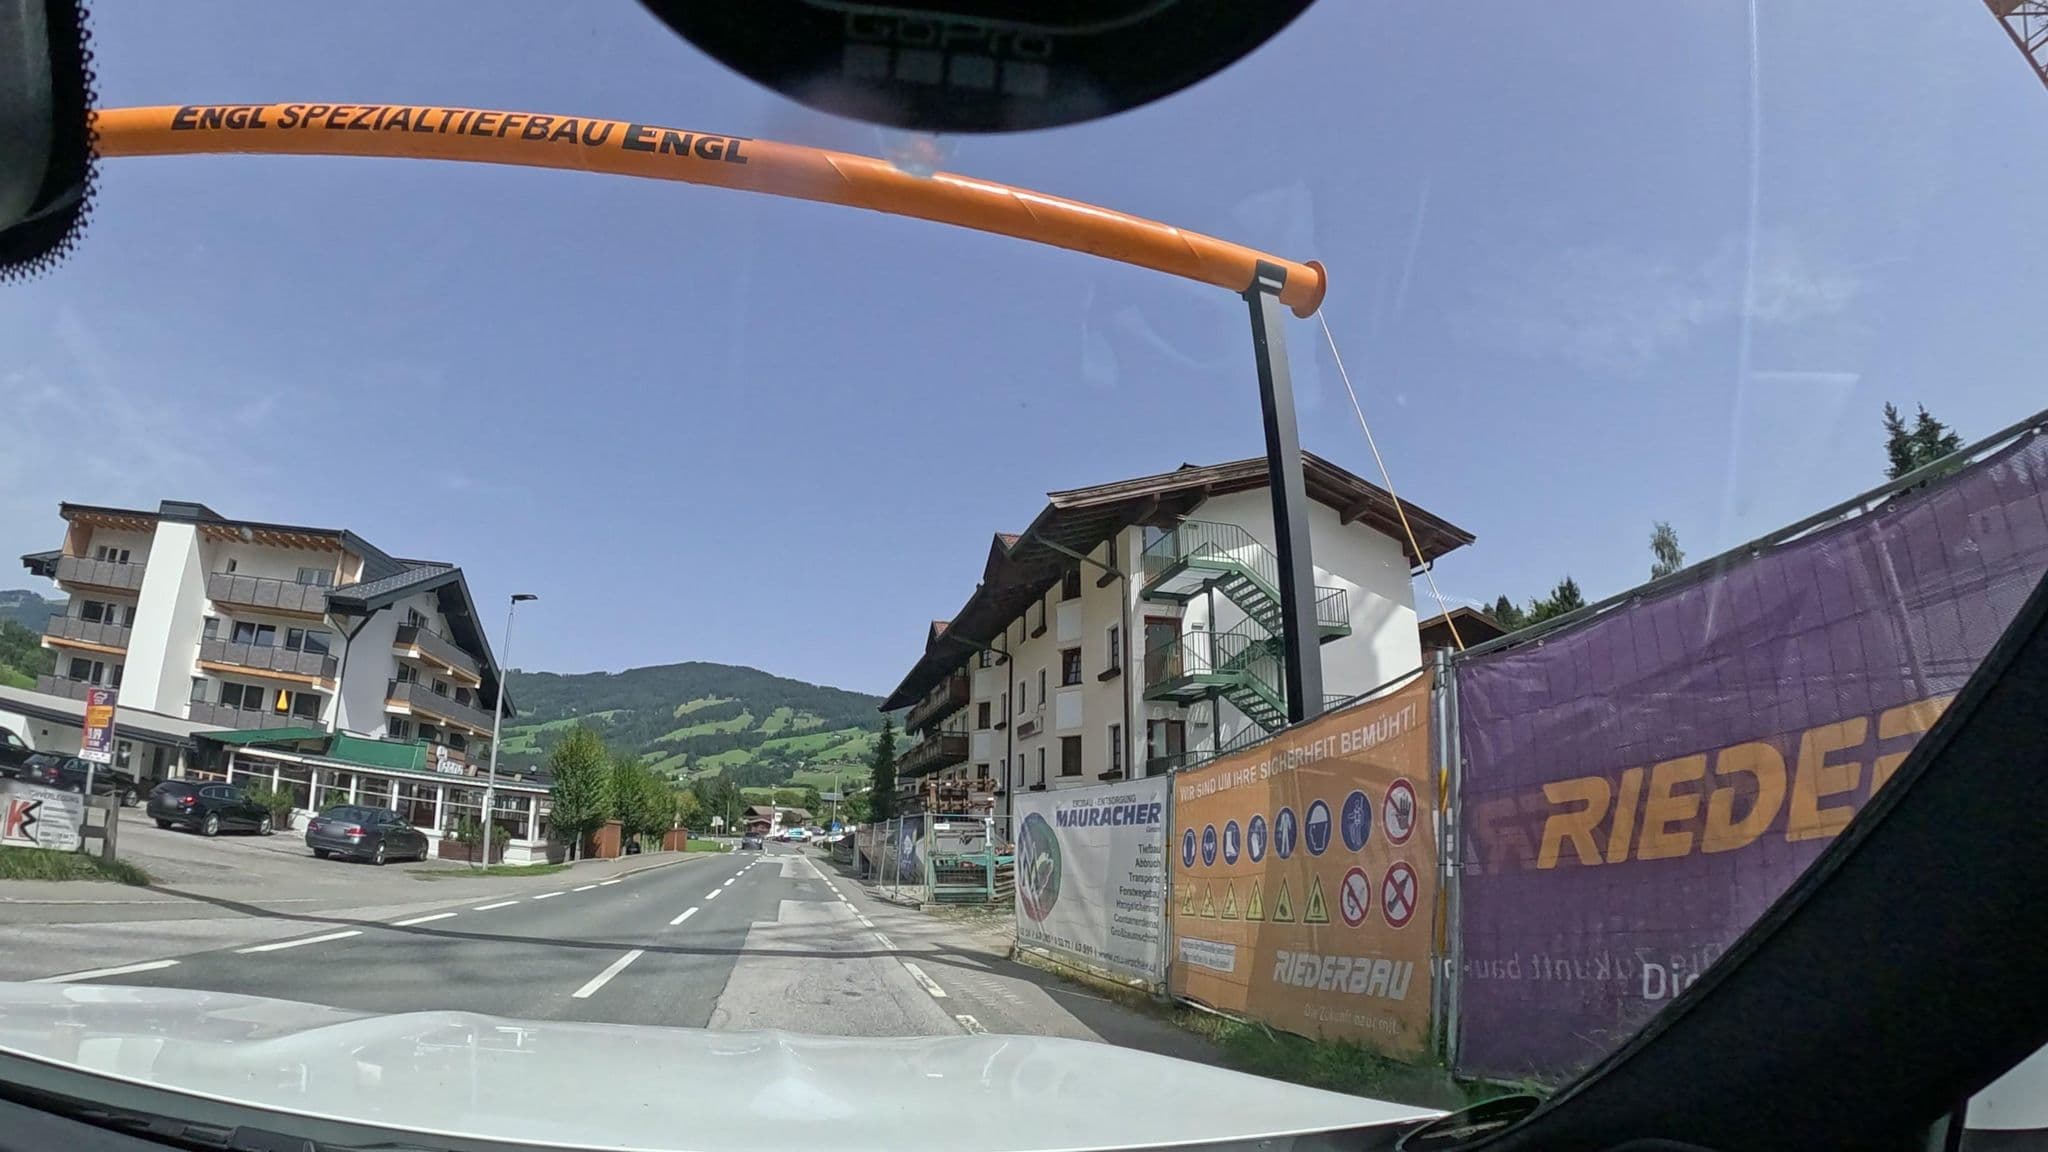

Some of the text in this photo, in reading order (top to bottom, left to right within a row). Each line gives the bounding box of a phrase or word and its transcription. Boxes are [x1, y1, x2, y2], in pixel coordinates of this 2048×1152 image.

[171, 105, 749, 165] ENGL SPEZIALTIEFBAU ENGL
[1179, 703, 1417, 801] WIR SIND UM IHRE SICHERHEIT BEMÜHT!
[1055, 802, 1162, 828] MAURACHER
[1273, 949, 1415, 1001] RIEDERBAU
